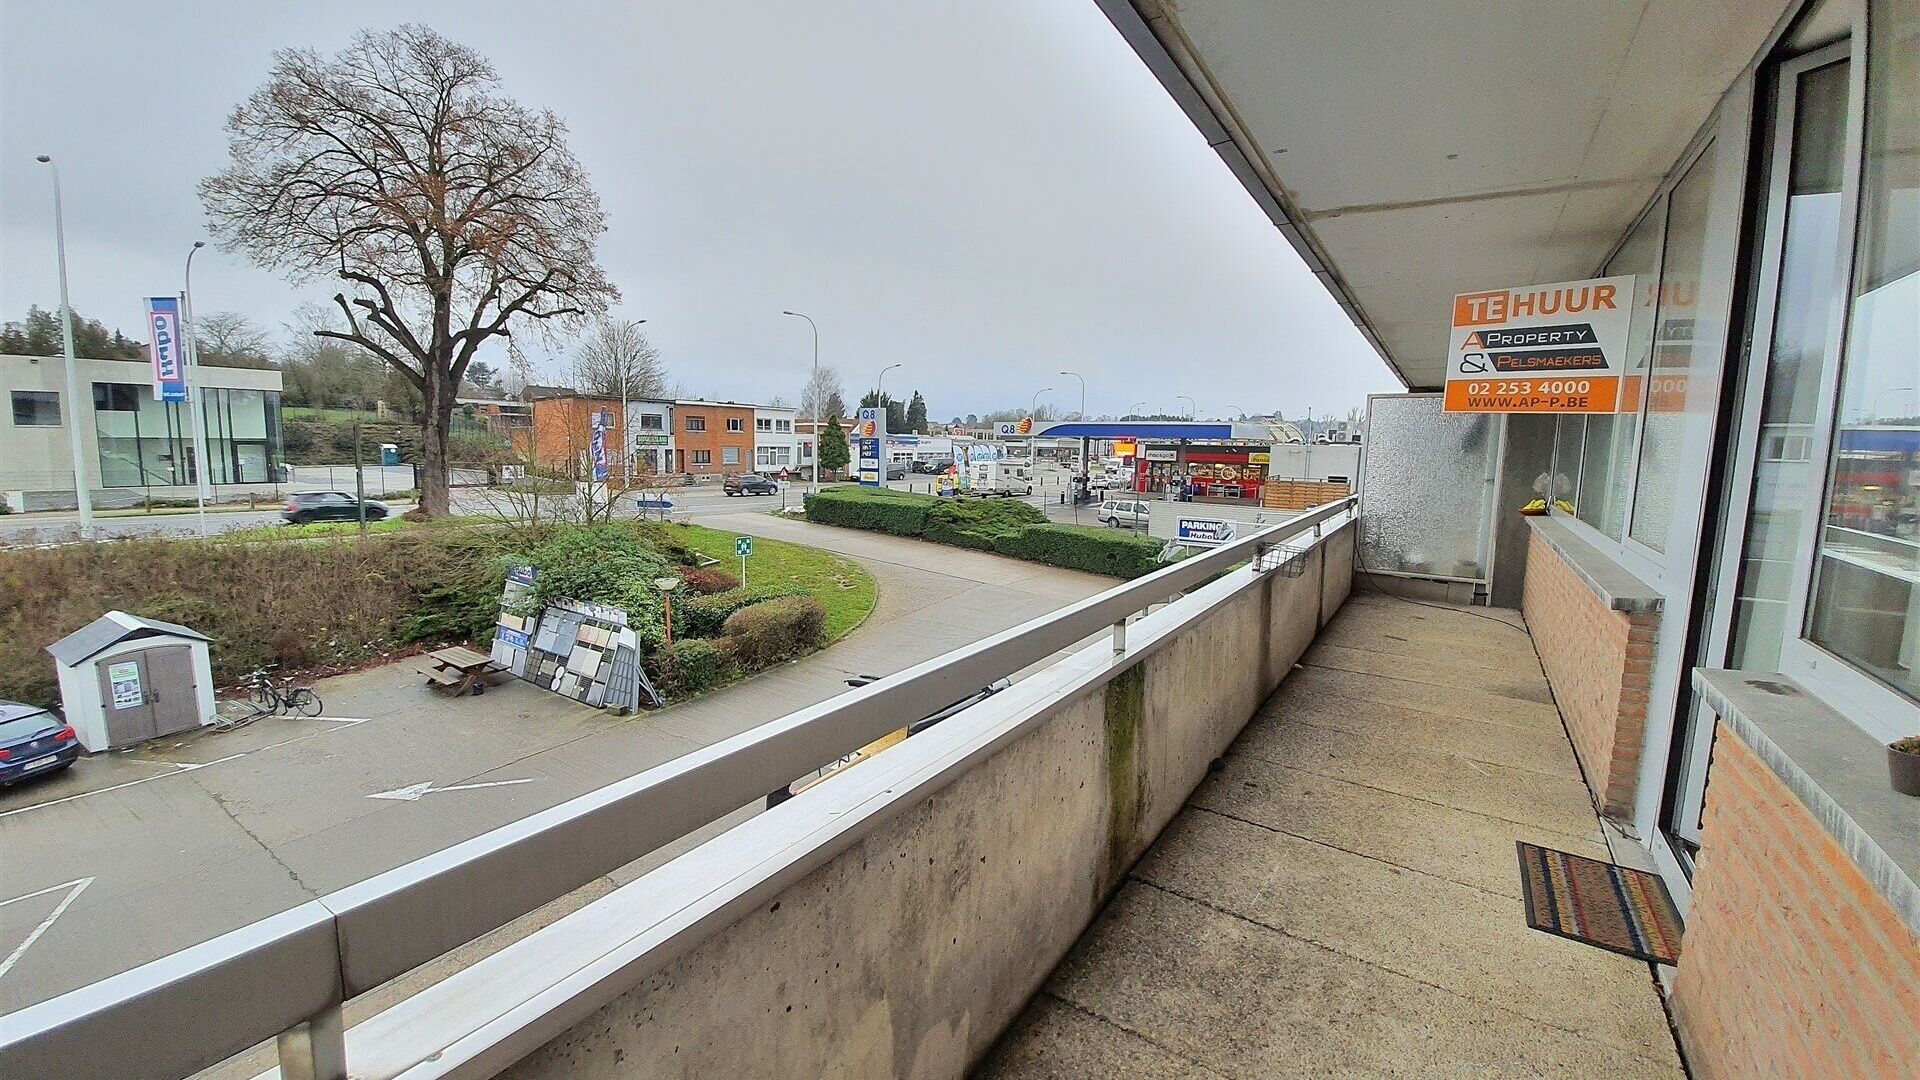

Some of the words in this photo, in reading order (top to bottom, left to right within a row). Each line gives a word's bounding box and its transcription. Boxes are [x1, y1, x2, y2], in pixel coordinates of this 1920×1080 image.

[1467, 296, 1503, 321] TE
[1512, 284, 1617, 317] HUUR
[1460, 331, 1485, 350] A
[1486, 329, 1587, 346] PROPERTY
[1459, 353, 1488, 373] &
[1497, 354, 1601, 369] PELSMAEKERS
[1468, 382, 1490, 395] 02
[1496, 381, 1531, 395] 253
[1538, 380, 1590, 394] 4000
[862, 410, 876, 420] Q8
[1001, 424, 1015, 435] Q8
[1181, 521, 1222, 531] PARKING
[1190, 532, 1213, 540] Hubo
